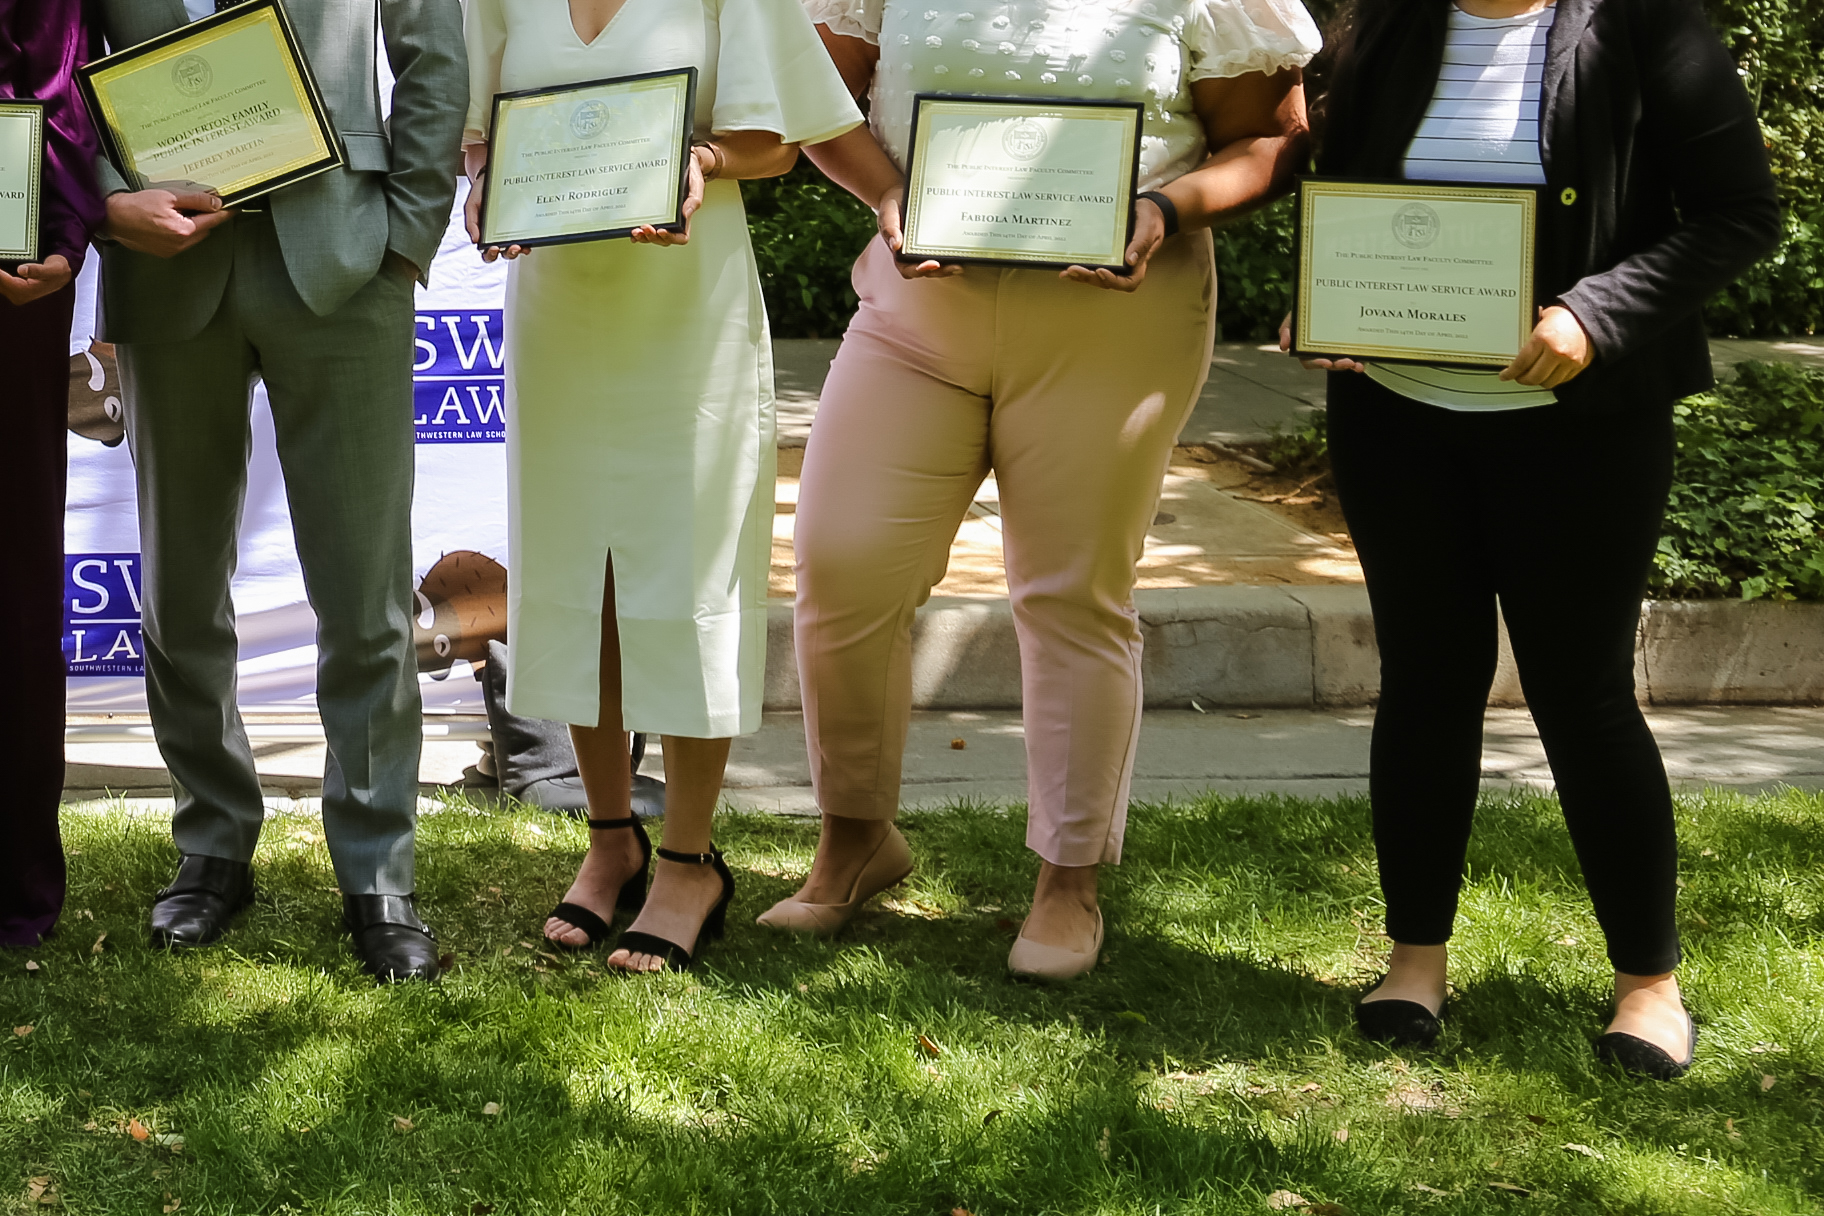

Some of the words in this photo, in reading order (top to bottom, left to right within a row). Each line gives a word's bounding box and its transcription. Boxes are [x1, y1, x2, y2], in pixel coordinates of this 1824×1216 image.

[152, 141, 188, 162] PUBLIC
[191, 122, 240, 148] INTEREST
[243, 106, 280, 128] AWARD
[156, 115, 229, 149] WOOLVERTON
[231, 100, 268, 122] FAMILY
[183, 151, 223, 174] JEFFREY
[226, 136, 264, 158] MARTIN
[503, 174, 534, 185] PUBLIC
[535, 169, 577, 181] INTEREST
[578, 166, 597, 176] LAW
[598, 162, 633, 174] SERVICE
[635, 158, 667, 170] AWARD
[536, 192, 564, 204] ELENI
[568, 185, 627, 200] RODRIGUEZ
[926, 188, 960, 197] PUBLIC
[963, 189, 1009, 199] INTEREST
[1011, 191, 1032, 200] LAW
[1034, 192, 1075, 202] SERVICE
[1077, 194, 1113, 204] AWARD
[1011, 214, 1071, 226] MARTINEZ
[1315, 278, 1352, 288] PUBLIC
[1355, 280, 1404, 291] INTEREST
[1406, 283, 1428, 292] LAW
[1431, 284, 1474, 295] SERVICE
[1476, 287, 1516, 297] AWARD
[1407, 308, 1466, 322] MORALES
[413, 315, 505, 371] SW
[71, 630, 142, 663] LA
